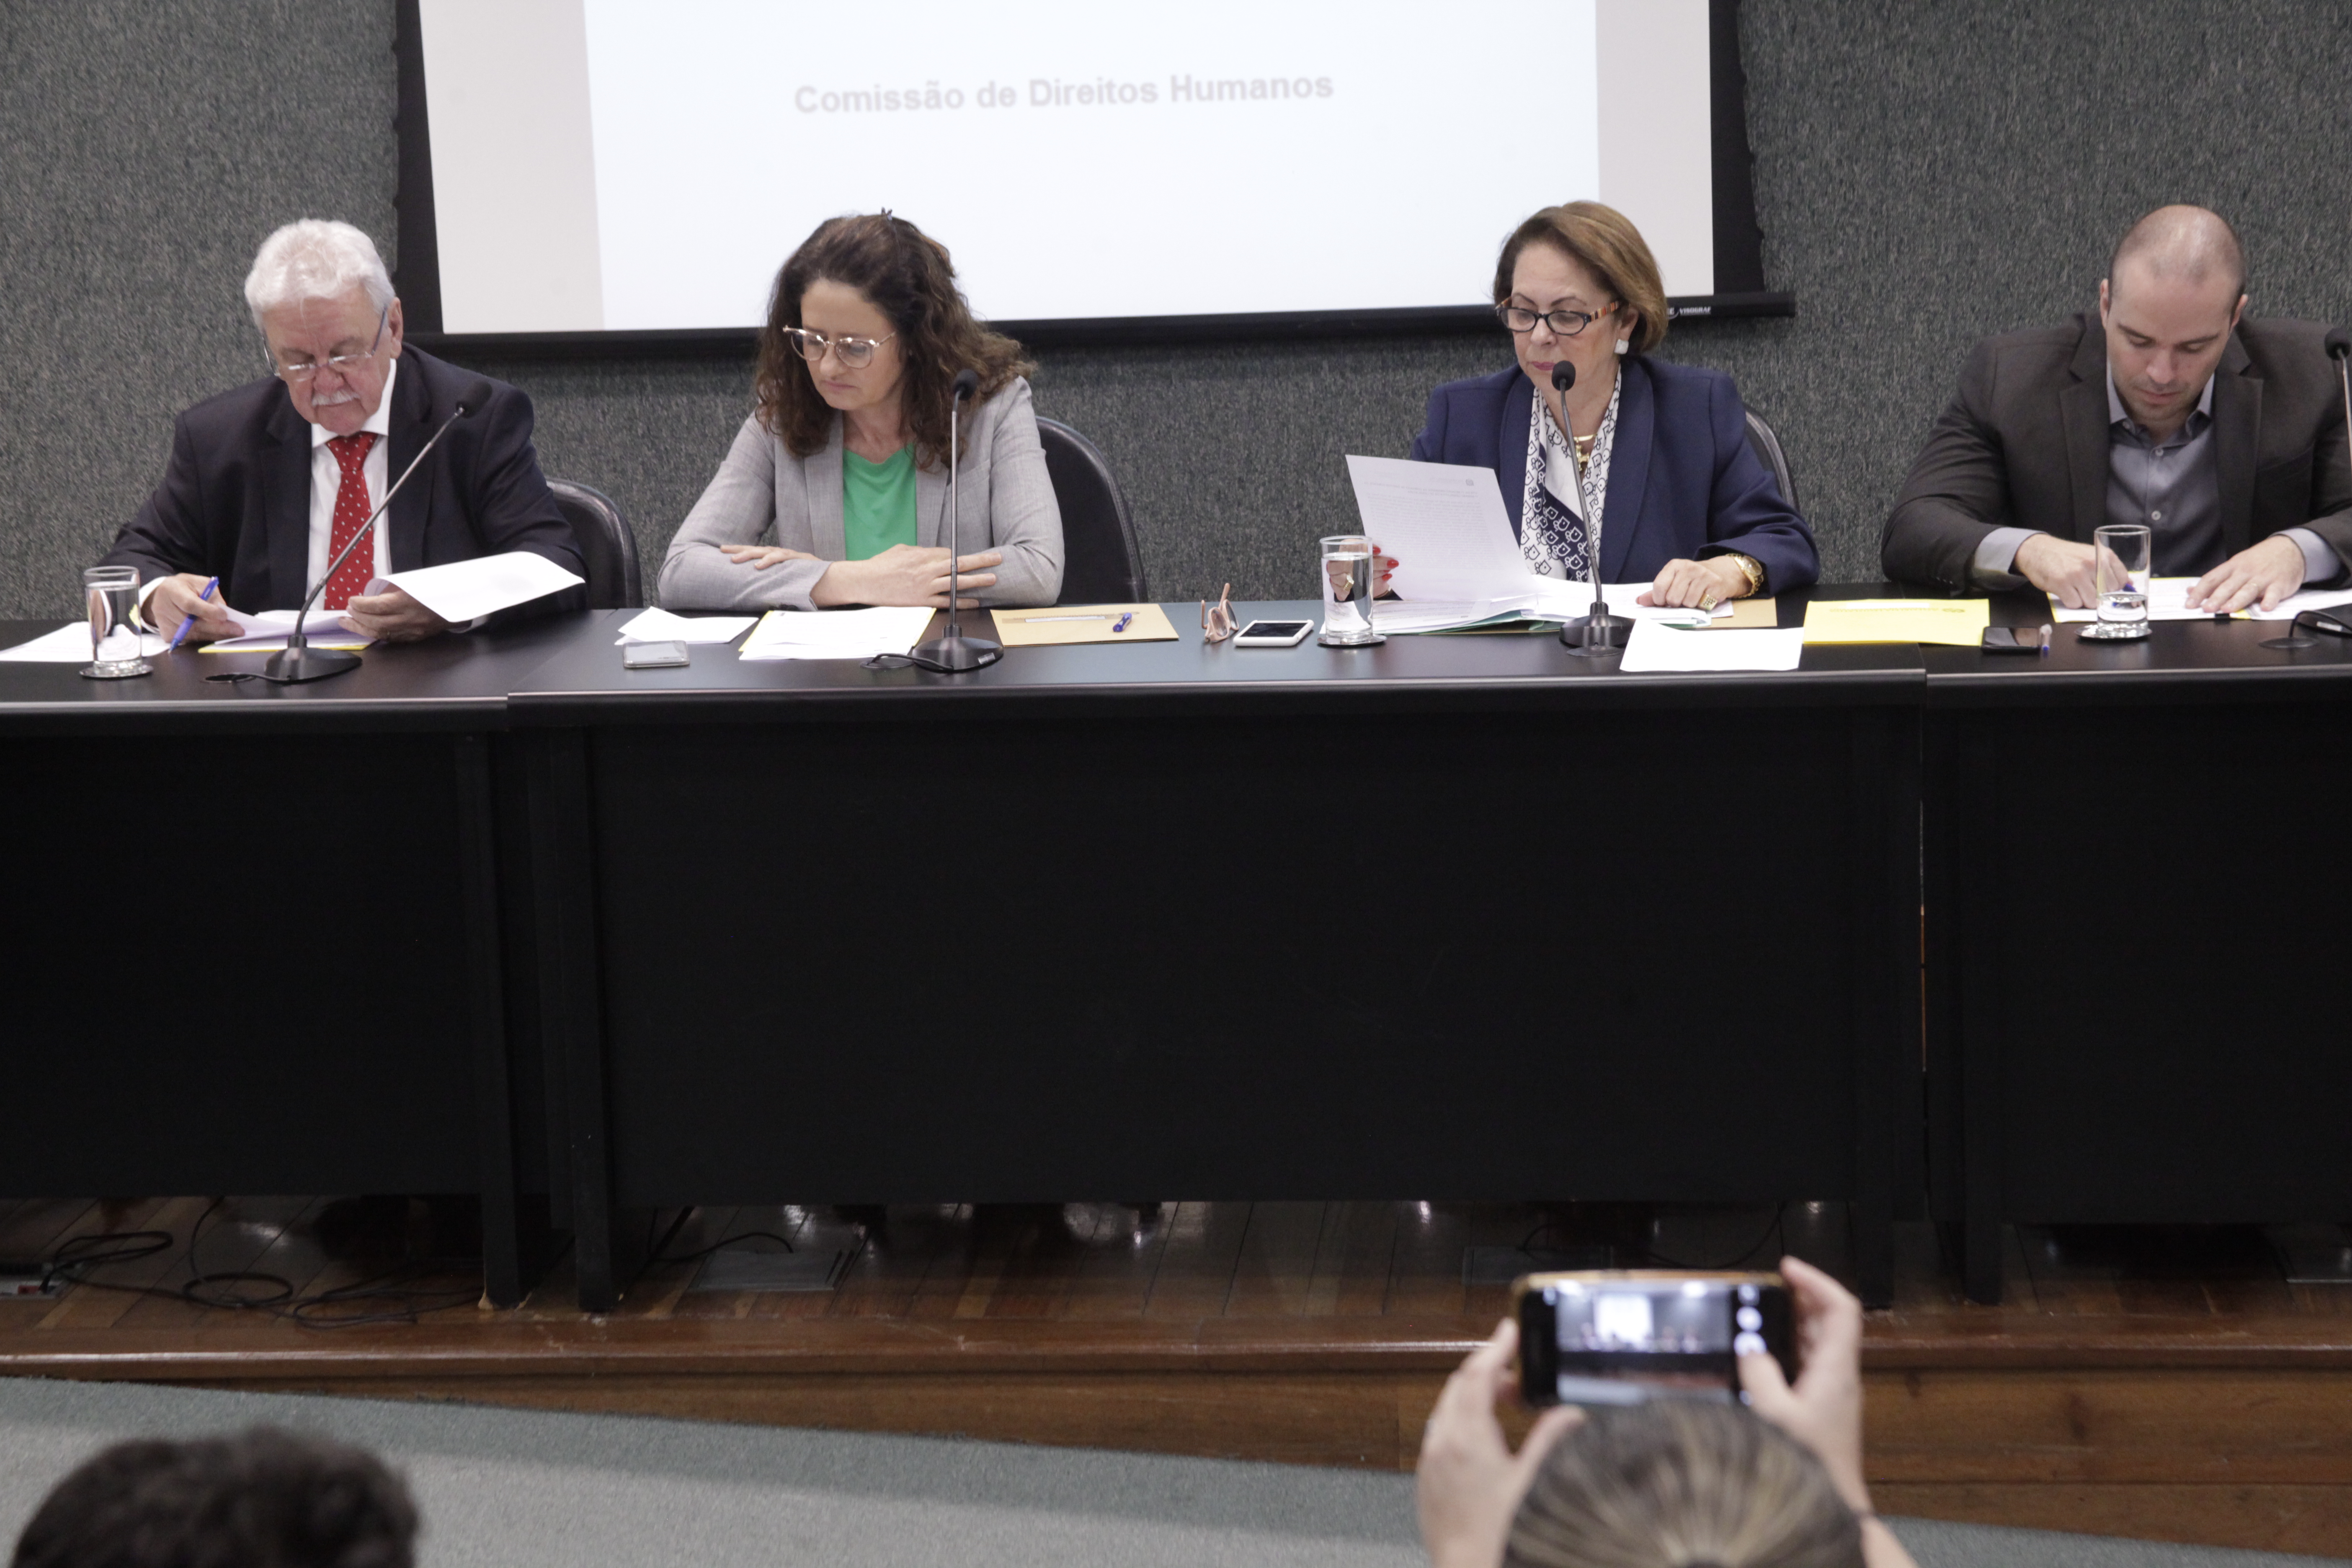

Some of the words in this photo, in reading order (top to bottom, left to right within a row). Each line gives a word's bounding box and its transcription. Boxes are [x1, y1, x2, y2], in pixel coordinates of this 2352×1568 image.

[794, 80, 965, 114] Comissão
[976, 80, 1017, 109] de
[1029, 76, 1159, 107] Direitos
[1170, 74, 1334, 103] Humanos
